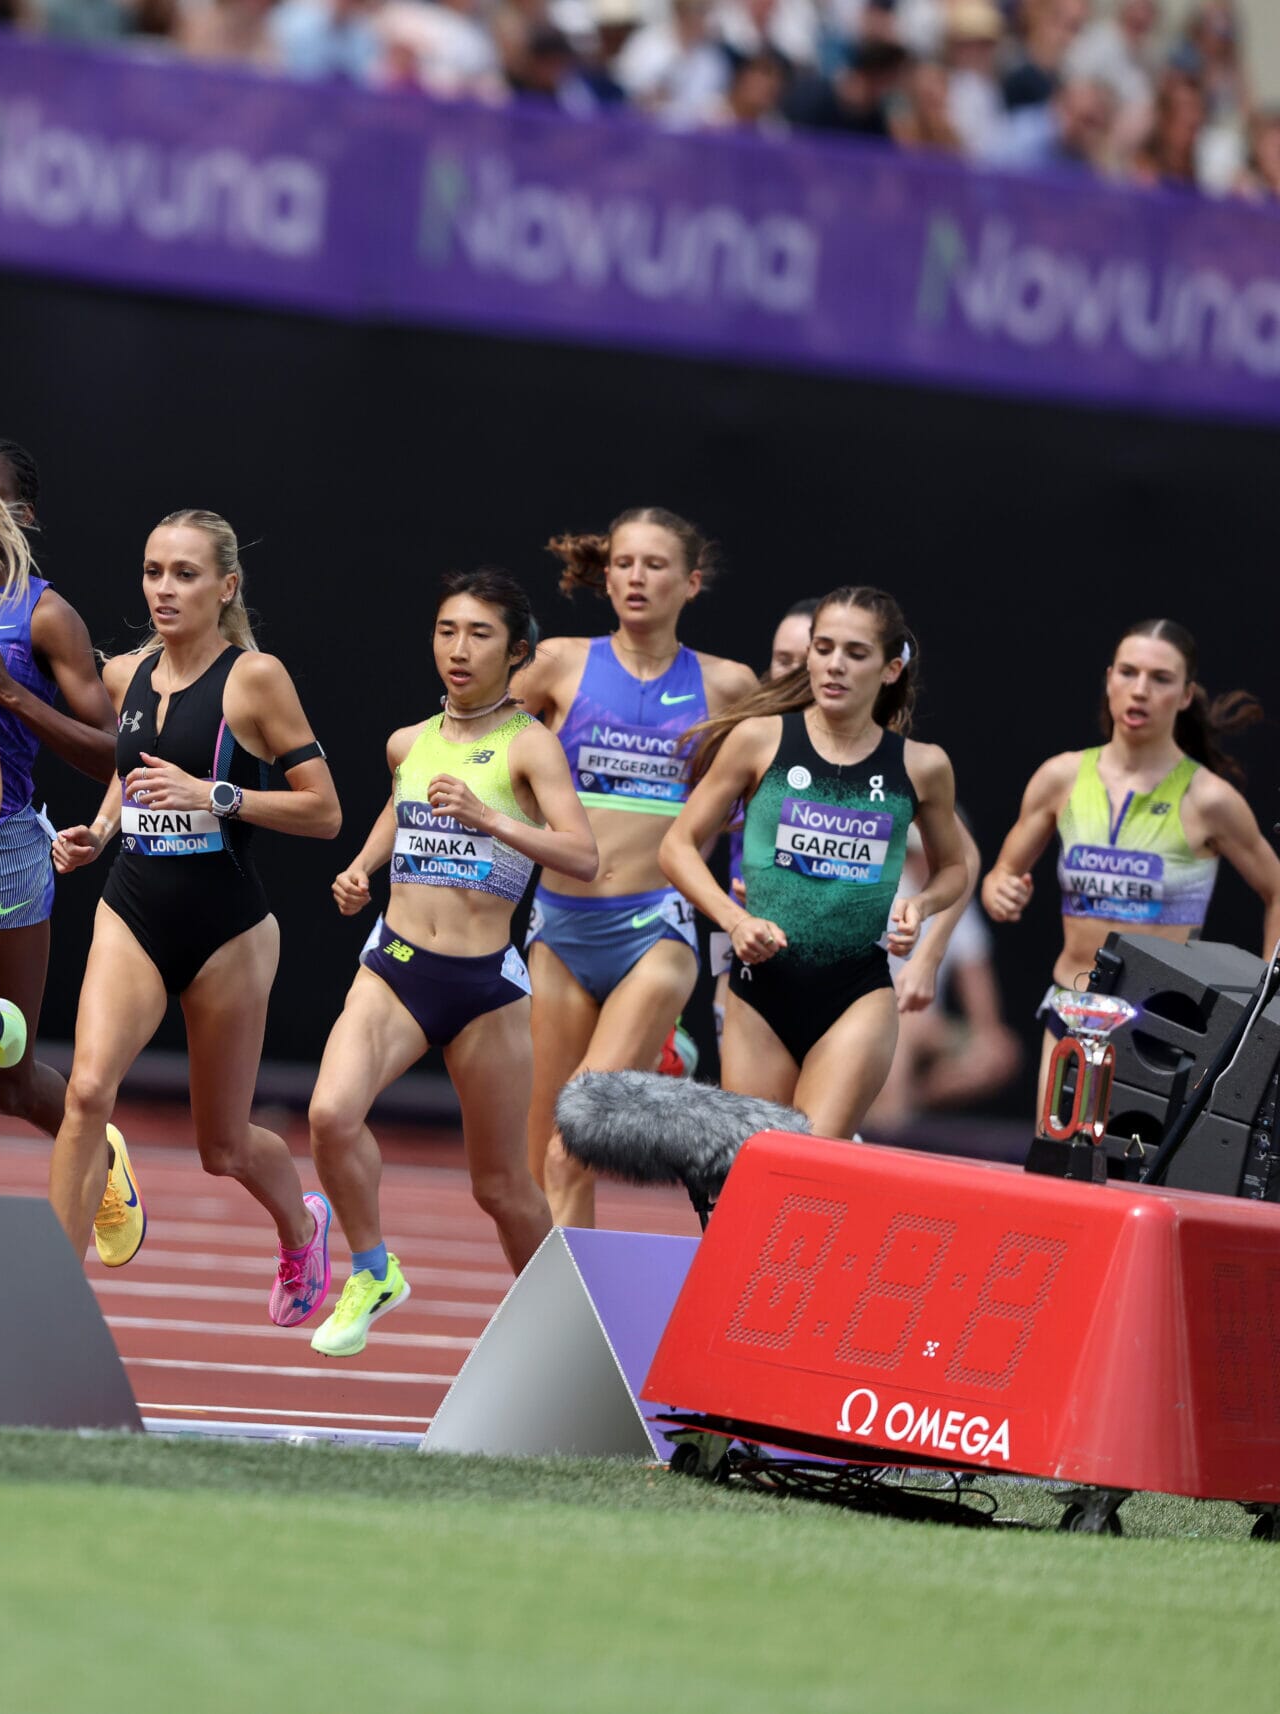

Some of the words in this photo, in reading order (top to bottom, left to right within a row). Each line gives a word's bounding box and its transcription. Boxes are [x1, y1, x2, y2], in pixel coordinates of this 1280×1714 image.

[419, 151, 816, 314] Novuna
[592, 725, 677, 755] Novuna
[588, 754, 679, 777] FITZGERALD
[614, 779, 672, 797] LONDON
[138, 814, 192, 833] RYAN
[791, 803, 878, 836] Novuna
[151, 837, 209, 852] LONDON
[409, 835, 477, 856] TANAKA
[791, 833, 871, 861] GARCÍA
[420, 859, 479, 877] LONDON
[812, 860, 870, 879] LONDON
[1072, 847, 1150, 876] Novuna
[1070, 875, 1153, 900] WALKER
[1093, 899, 1150, 914] LONDON
[885, 1401, 1010, 1461] OMEGA
